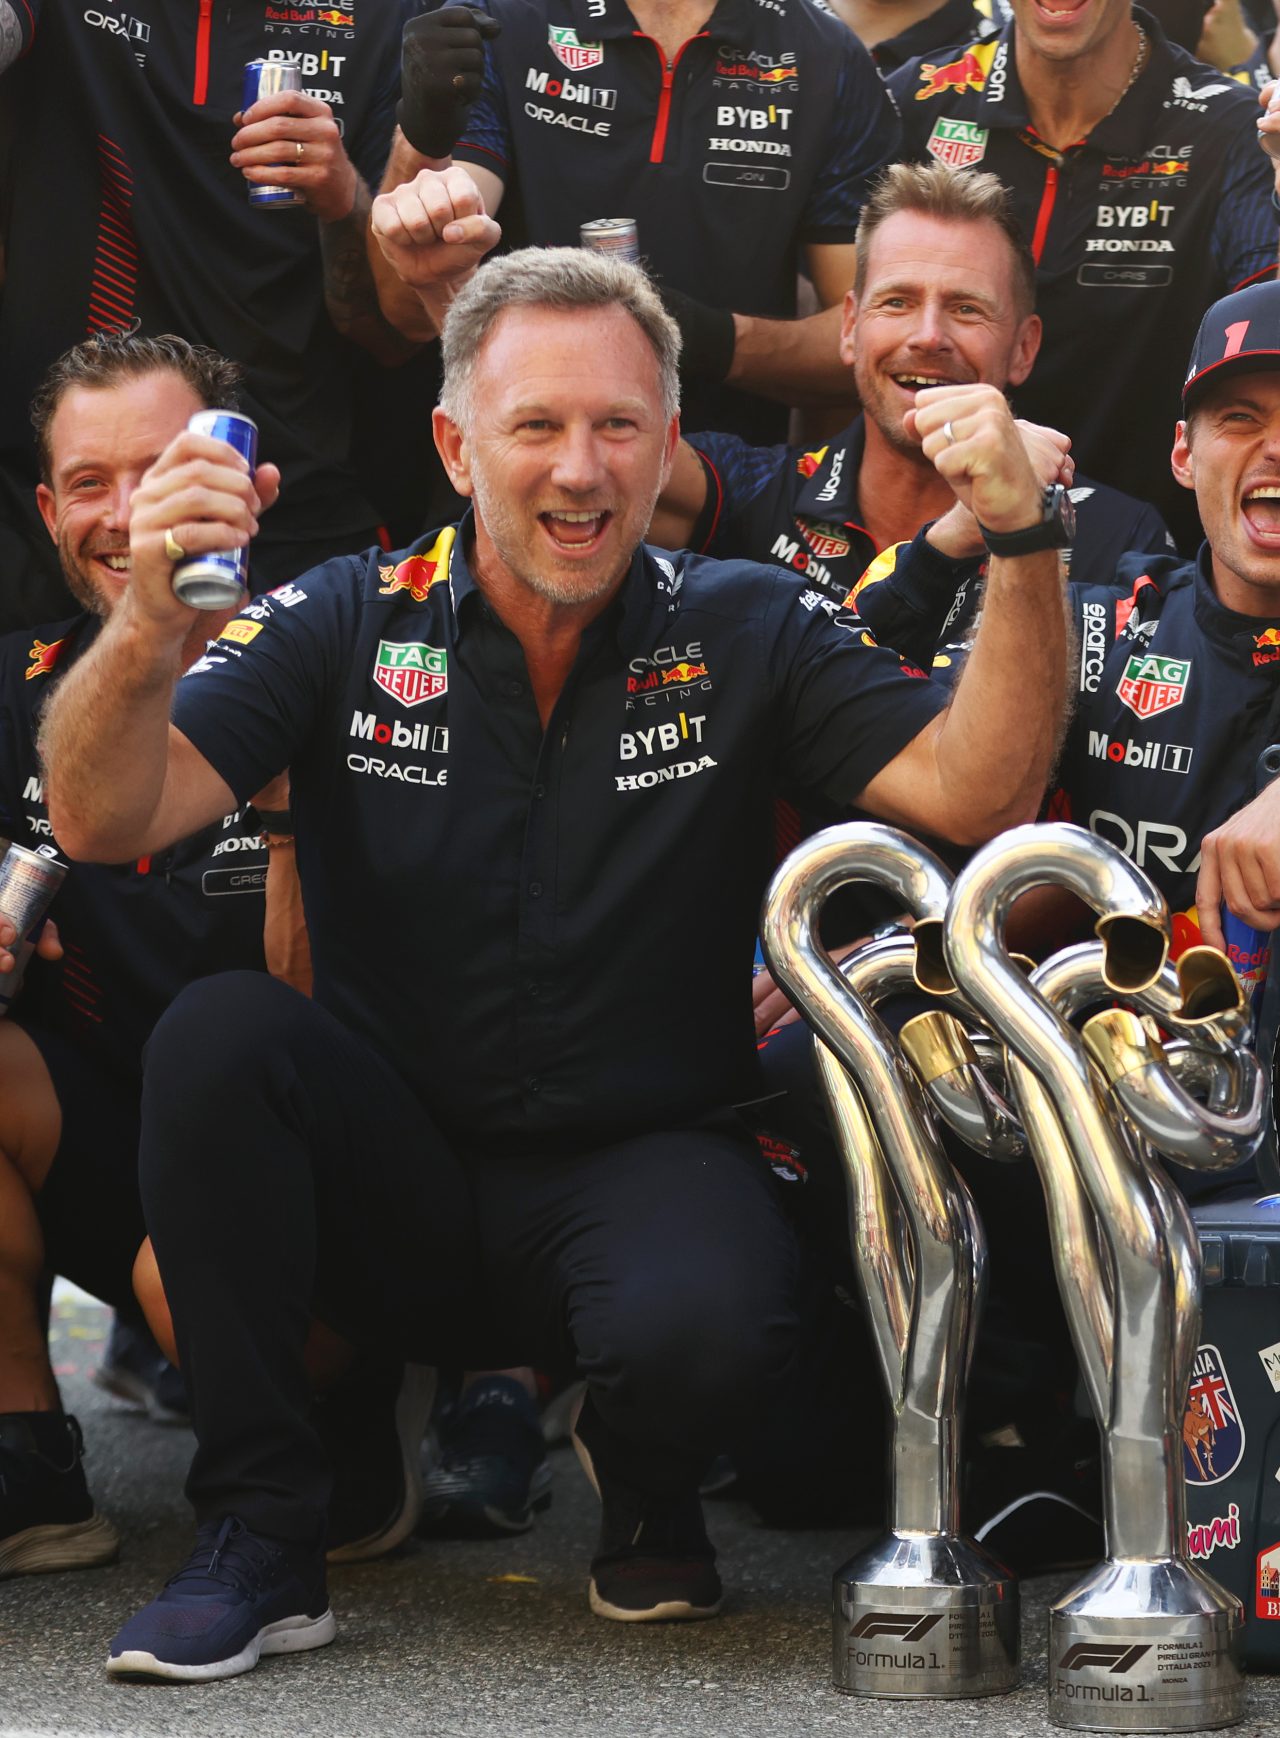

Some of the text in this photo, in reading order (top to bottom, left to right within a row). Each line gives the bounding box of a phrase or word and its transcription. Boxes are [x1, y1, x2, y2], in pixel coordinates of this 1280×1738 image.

[265, 7, 315, 21] Red Bull
[264, 25, 355, 39] RACING
[551, 30, 597, 48] TA
[556, 46, 600, 69] EUER
[717, 45, 797, 69] ORACLE
[300, 88, 344, 105] NDA
[525, 67, 591, 106] Mobil
[711, 79, 800, 95] RACING
[524, 102, 611, 137] ORACLE
[716, 105, 793, 131] BYBIT
[941, 121, 984, 142] TAG
[708, 137, 793, 157] HONDA
[735, 172, 765, 182] JON
[1097, 200, 1175, 229] BYBIT
[1086, 240, 1175, 252] HONDA
[1224, 320, 1251, 359] 1
[815, 448, 847, 502] zoom
[770, 533, 832, 585] Mobil
[1081, 602, 1107, 693] sparco
[1119, 628, 1151, 649] ASTOR
[385, 645, 442, 672] TAG
[1252, 646, 1280, 667] Red
[1134, 659, 1183, 682] TAG
[377, 669, 446, 703] HEUER
[1122, 681, 1179, 713] HEUER
[349, 710, 427, 751] Mobil
[620, 712, 707, 760] BYBIT
[1088, 730, 1161, 770] Mobil
[346, 754, 447, 786] ORACLE
[616, 755, 717, 791] HONDA
[212, 835, 267, 858] HON
[230, 874, 268, 893] GRE
[1192, 1352, 1216, 1377] LIA
[1187, 1504, 1239, 1556] ami
[1157, 1641, 1203, 1651] FORMULA 1
[1157, 1653, 1188, 1661] PIRELLI
[1189, 1651, 1211, 1659] GRAN
[1157, 1661, 1211, 1671] D'ITALIA 2023
[1057, 1679, 1133, 1702] Formula
[1161, 1676, 1188, 1684] MONZA
